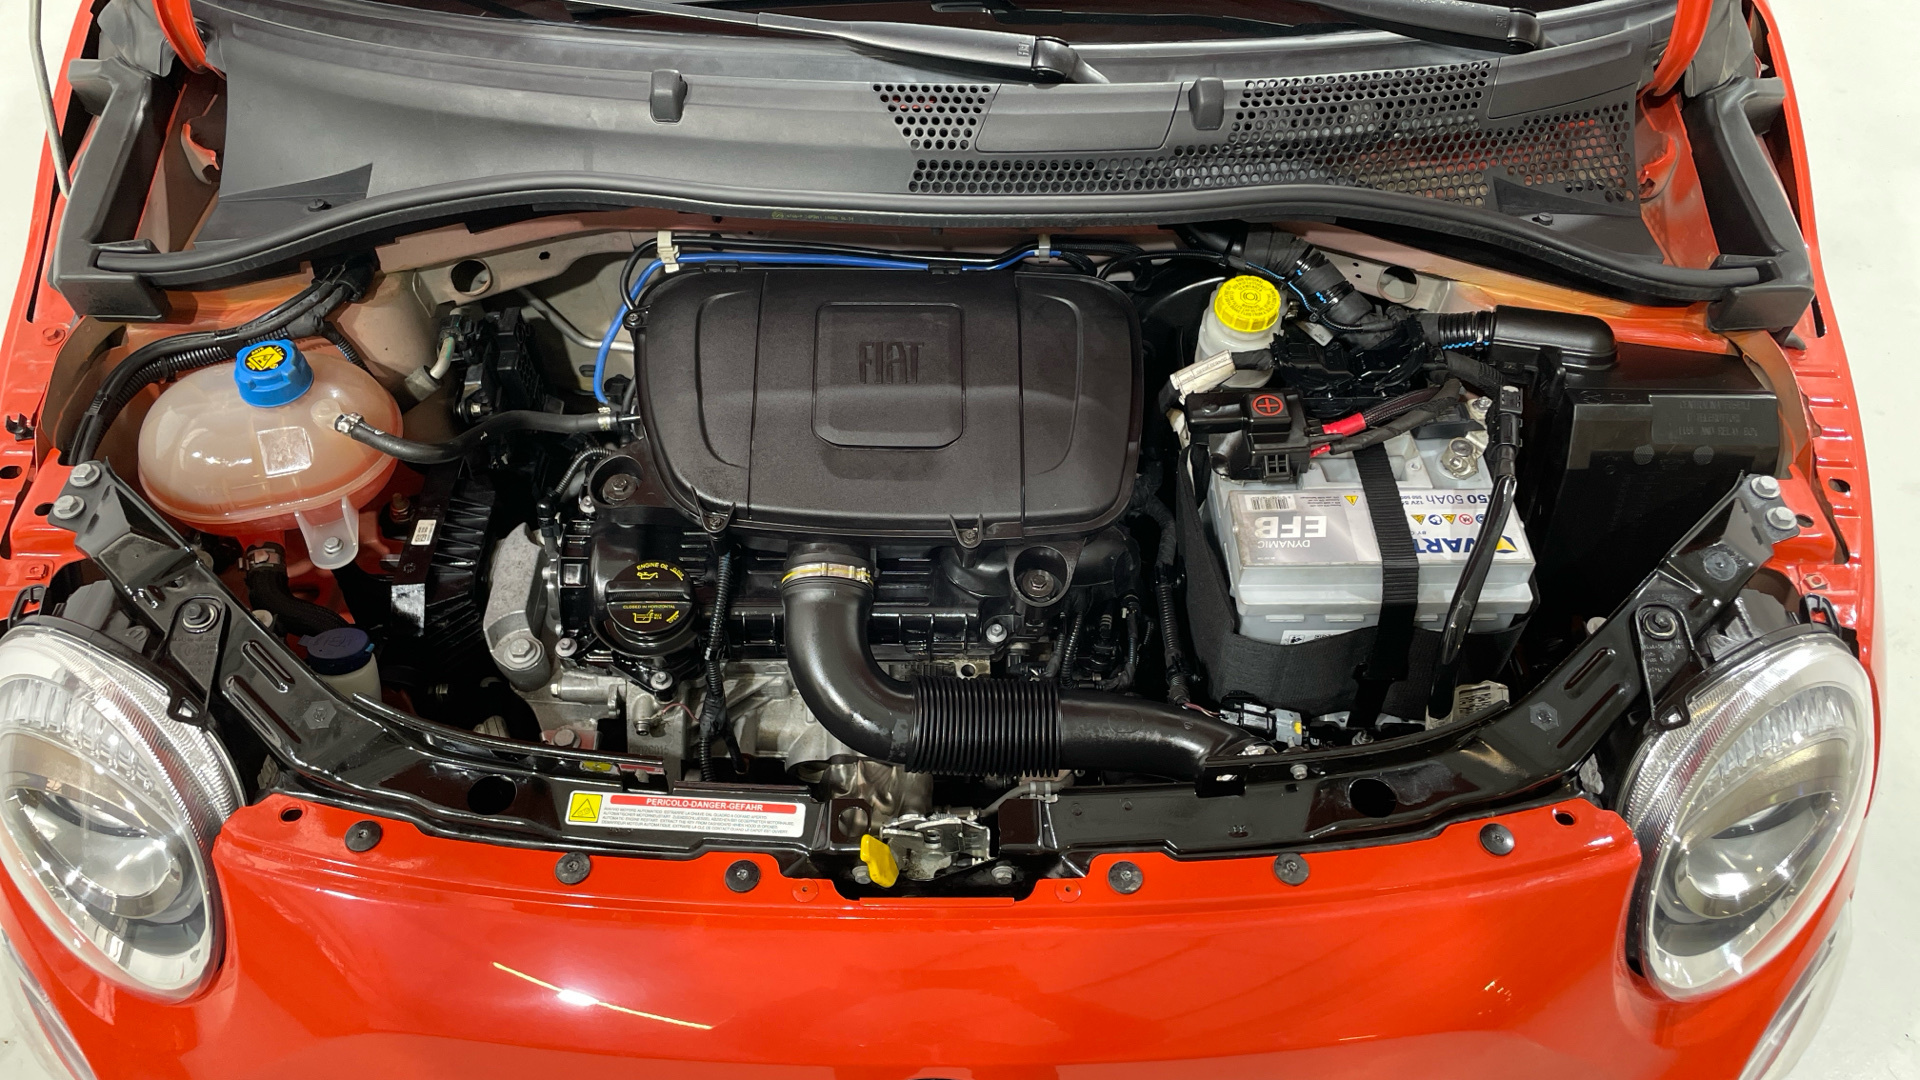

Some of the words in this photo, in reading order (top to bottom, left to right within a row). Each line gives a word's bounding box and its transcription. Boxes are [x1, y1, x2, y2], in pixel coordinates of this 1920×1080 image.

[859, 342, 924, 384] FIAT
[1426, 494, 1464, 504] 50Ah
[1467, 494, 1490, 504] 50
[1254, 516, 1327, 539] EFB
[1258, 539, 1310, 548] DYNAMIC
[1412, 538, 1475, 554] VART
[636, 562, 659, 570] ENGINE
[646, 798, 763, 811] PERICOLO-DANGER-GEFAHR
